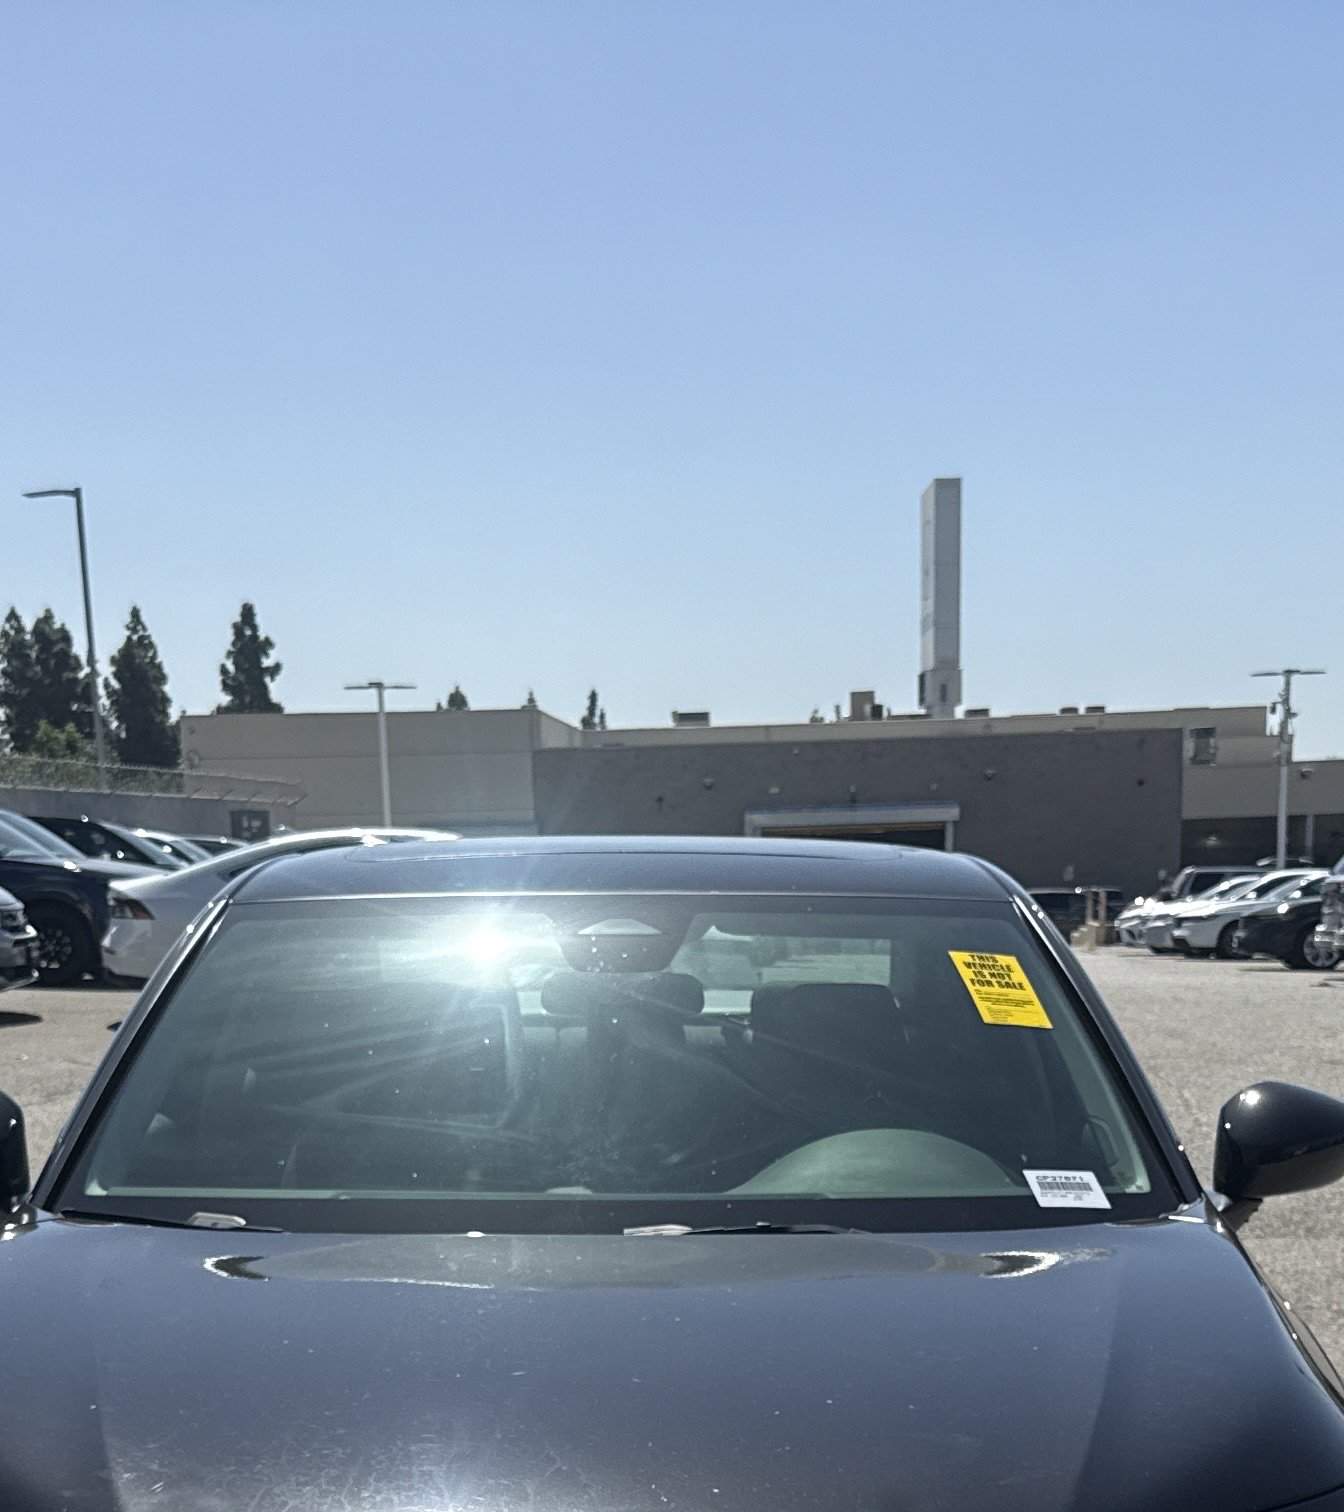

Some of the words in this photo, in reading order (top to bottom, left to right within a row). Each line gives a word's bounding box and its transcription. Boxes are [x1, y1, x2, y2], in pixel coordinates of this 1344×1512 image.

[968, 954, 999, 964] THIS
[963, 961, 1015, 973] VEHICLE
[972, 970, 987, 979] IS
[988, 972, 1013, 981] NOT
[969, 979, 995, 988] FOR
[996, 981, 1026, 991] SALE
